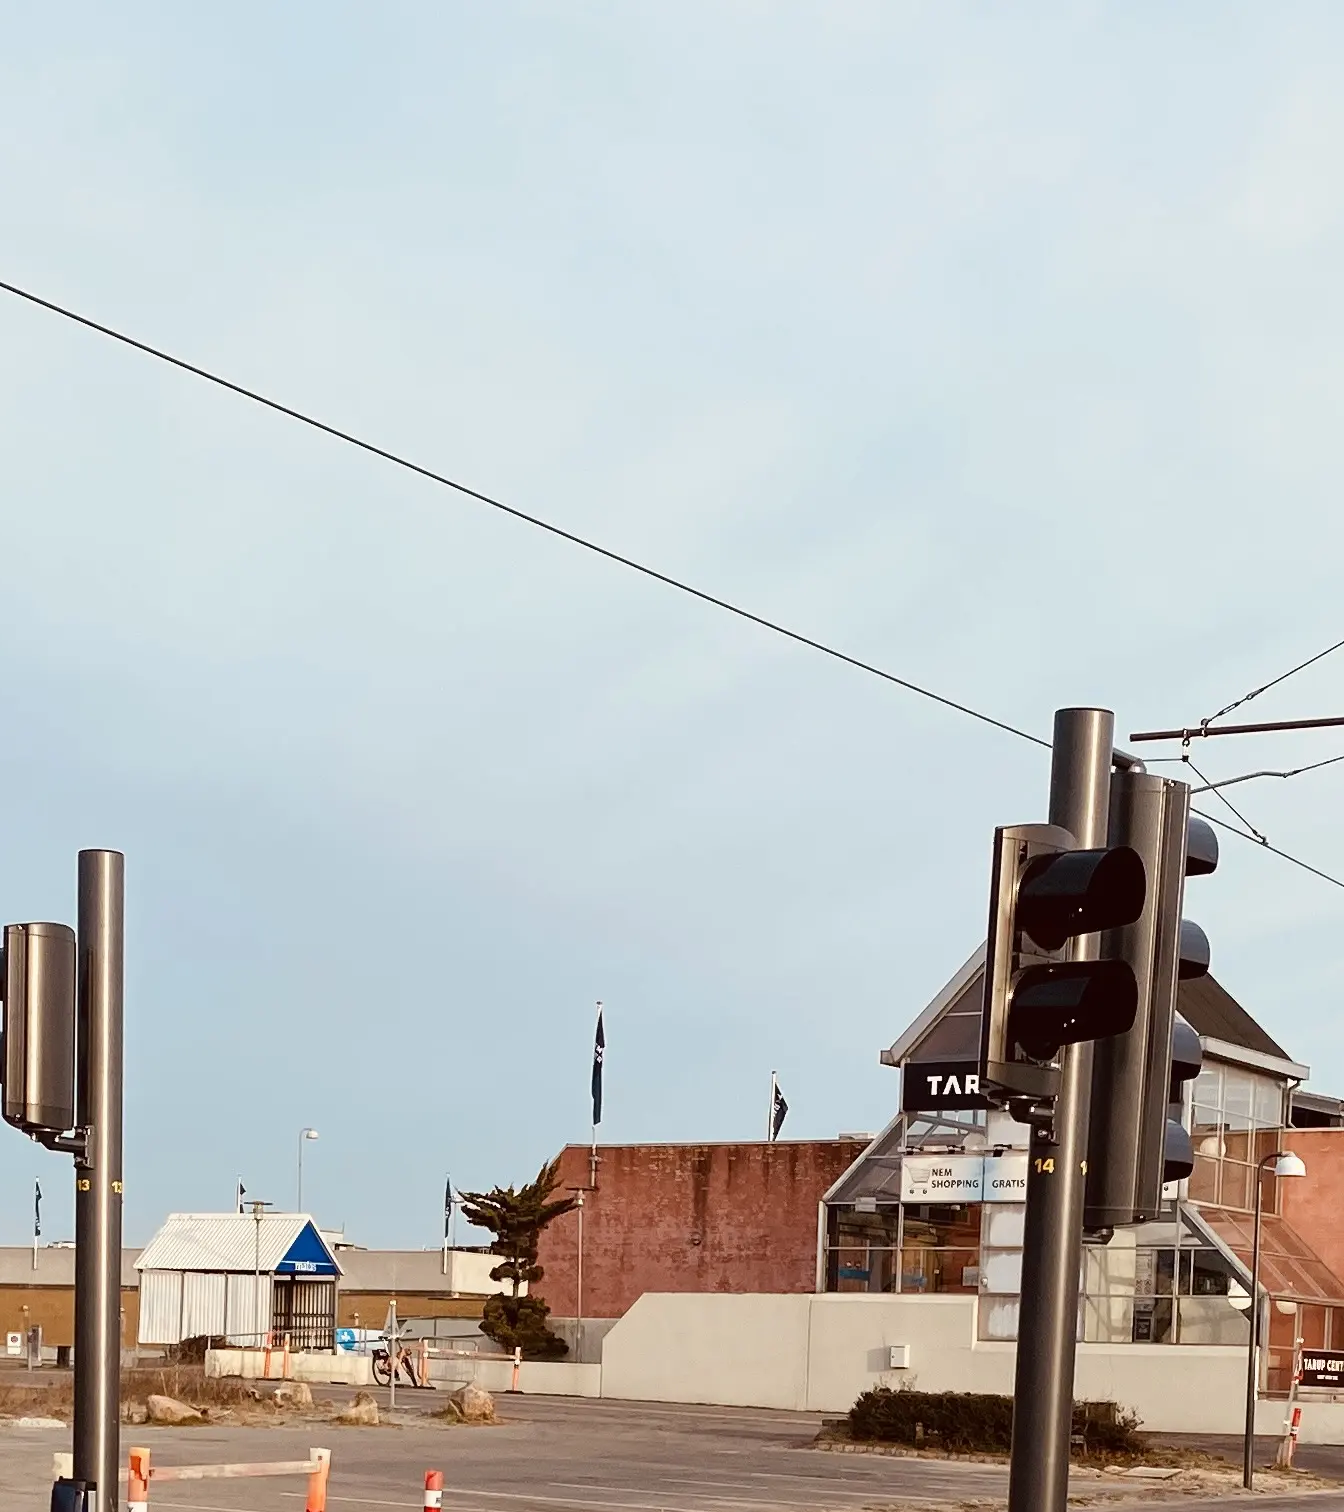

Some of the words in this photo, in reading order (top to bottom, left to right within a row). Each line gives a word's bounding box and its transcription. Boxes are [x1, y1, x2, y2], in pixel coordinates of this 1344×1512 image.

[926, 1074, 980, 1096] TAR
[1034, 1158, 1055, 1174] 14
[1080, 1160, 1088, 1176] 1
[931, 1168, 953, 1177] NEM
[77, 1179, 90, 1191] 13
[931, 1179, 980, 1189] SHOPPING
[991, 1178, 1026, 1189] GRATIS
